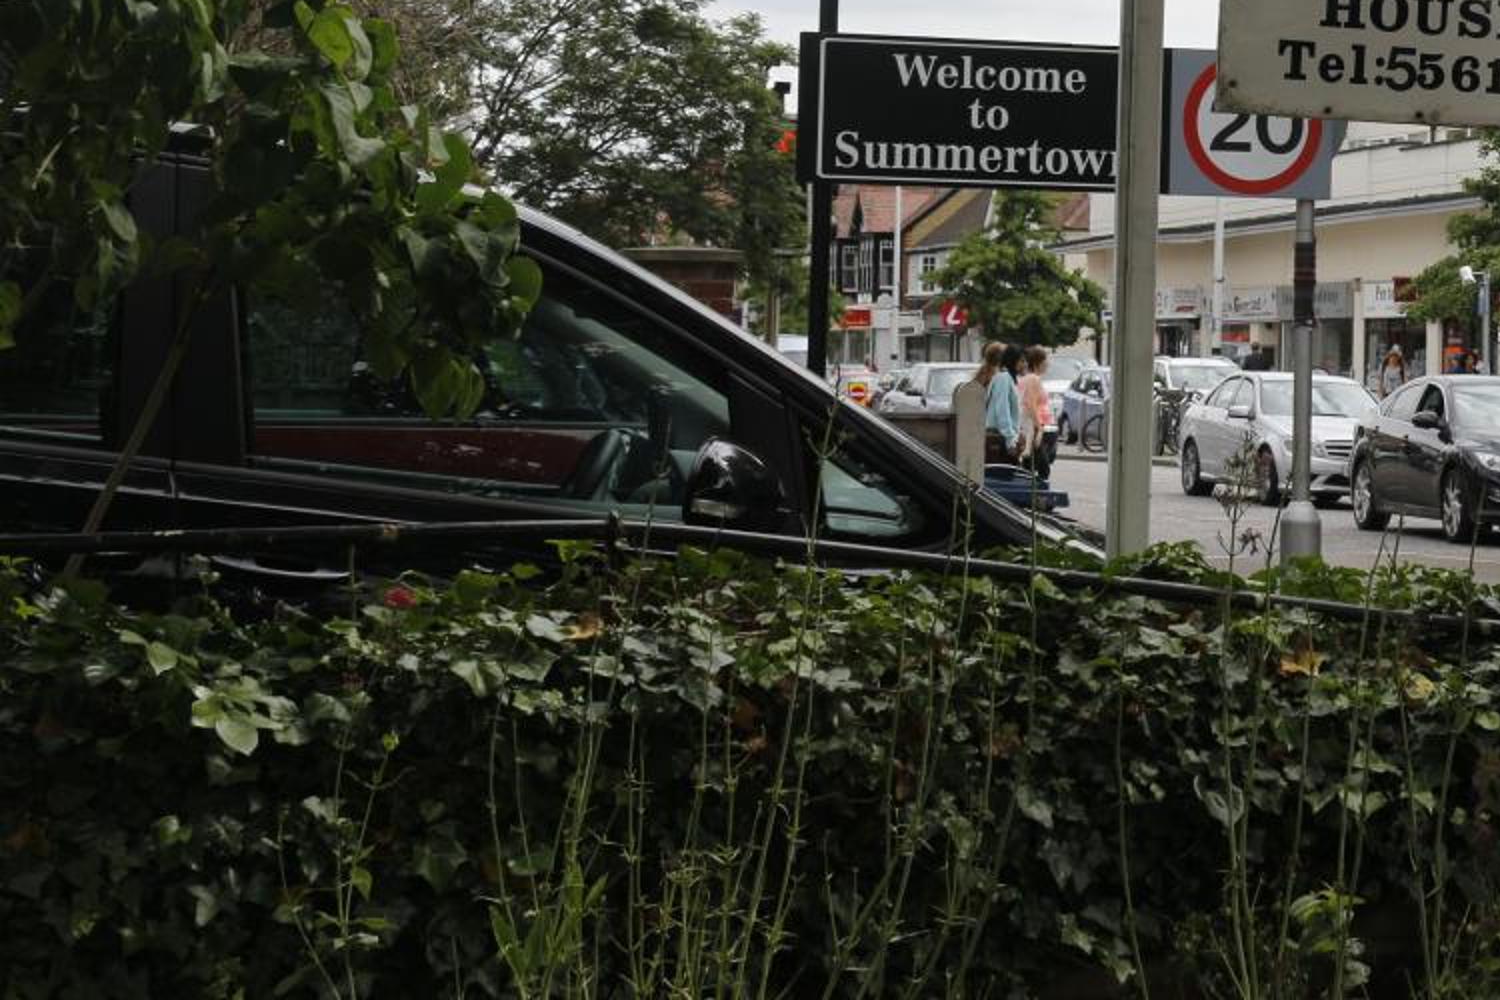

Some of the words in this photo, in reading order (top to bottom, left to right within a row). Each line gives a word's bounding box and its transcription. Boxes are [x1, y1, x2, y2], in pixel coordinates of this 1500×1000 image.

[893, 53, 1088, 95] Welcome
[967, 98, 1010, 131] to
[1209, 102, 1305, 155] 20
